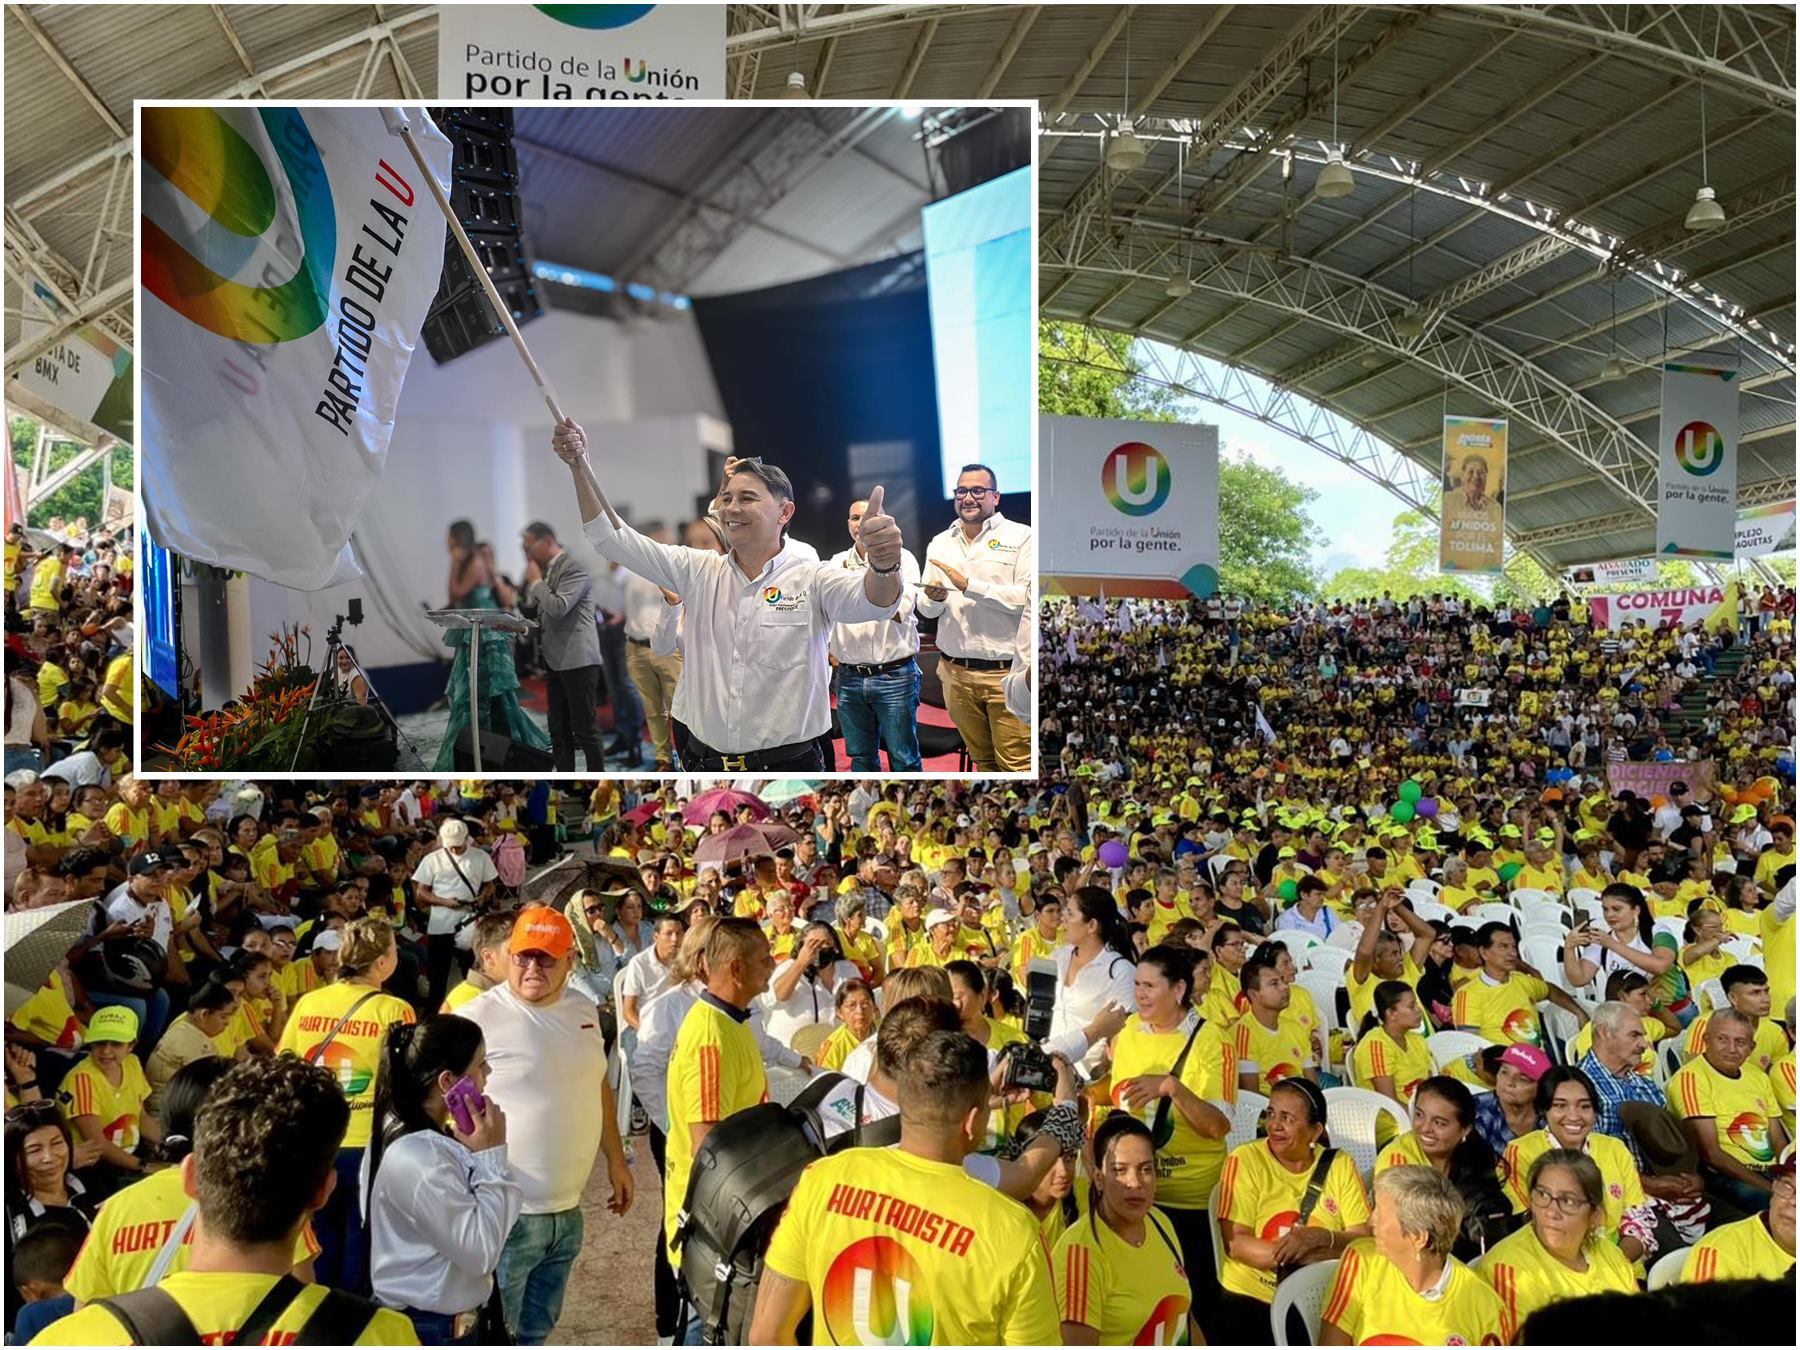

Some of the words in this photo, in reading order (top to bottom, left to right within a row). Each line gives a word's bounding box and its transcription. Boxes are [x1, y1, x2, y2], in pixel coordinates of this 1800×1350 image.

[466, 43, 552, 73] Partido
[560, 56, 590, 78] de
[598, 59, 617, 81] la
[624, 57, 699, 91] Unión
[466, 71, 531, 99] por
[543, 74, 573, 99] la
[375, 158, 415, 207] U
[362, 198, 408, 257] LA
[345, 243, 393, 303] DE
[35, 356, 60, 386] BMX
[67, 350, 81, 374] DE
[314, 296, 376, 437] PARTIDO
[1665, 490, 1684, 500] por
[1686, 491, 1696, 500] la
[1090, 527, 1124, 537] Partido
[1150, 526, 1181, 539] Unión
[1090, 537, 1116, 551] por
[1119, 536, 1132, 549] la
[1135, 540, 1182, 553] gente.
[1449, 540, 1496, 553] TOLIMA
[1616, 587, 1725, 610] COMUNA
[1661, 608, 1684, 634] 7
[145, 852, 161, 864] 12
[827, 1183, 976, 1257] HURTADISTA
